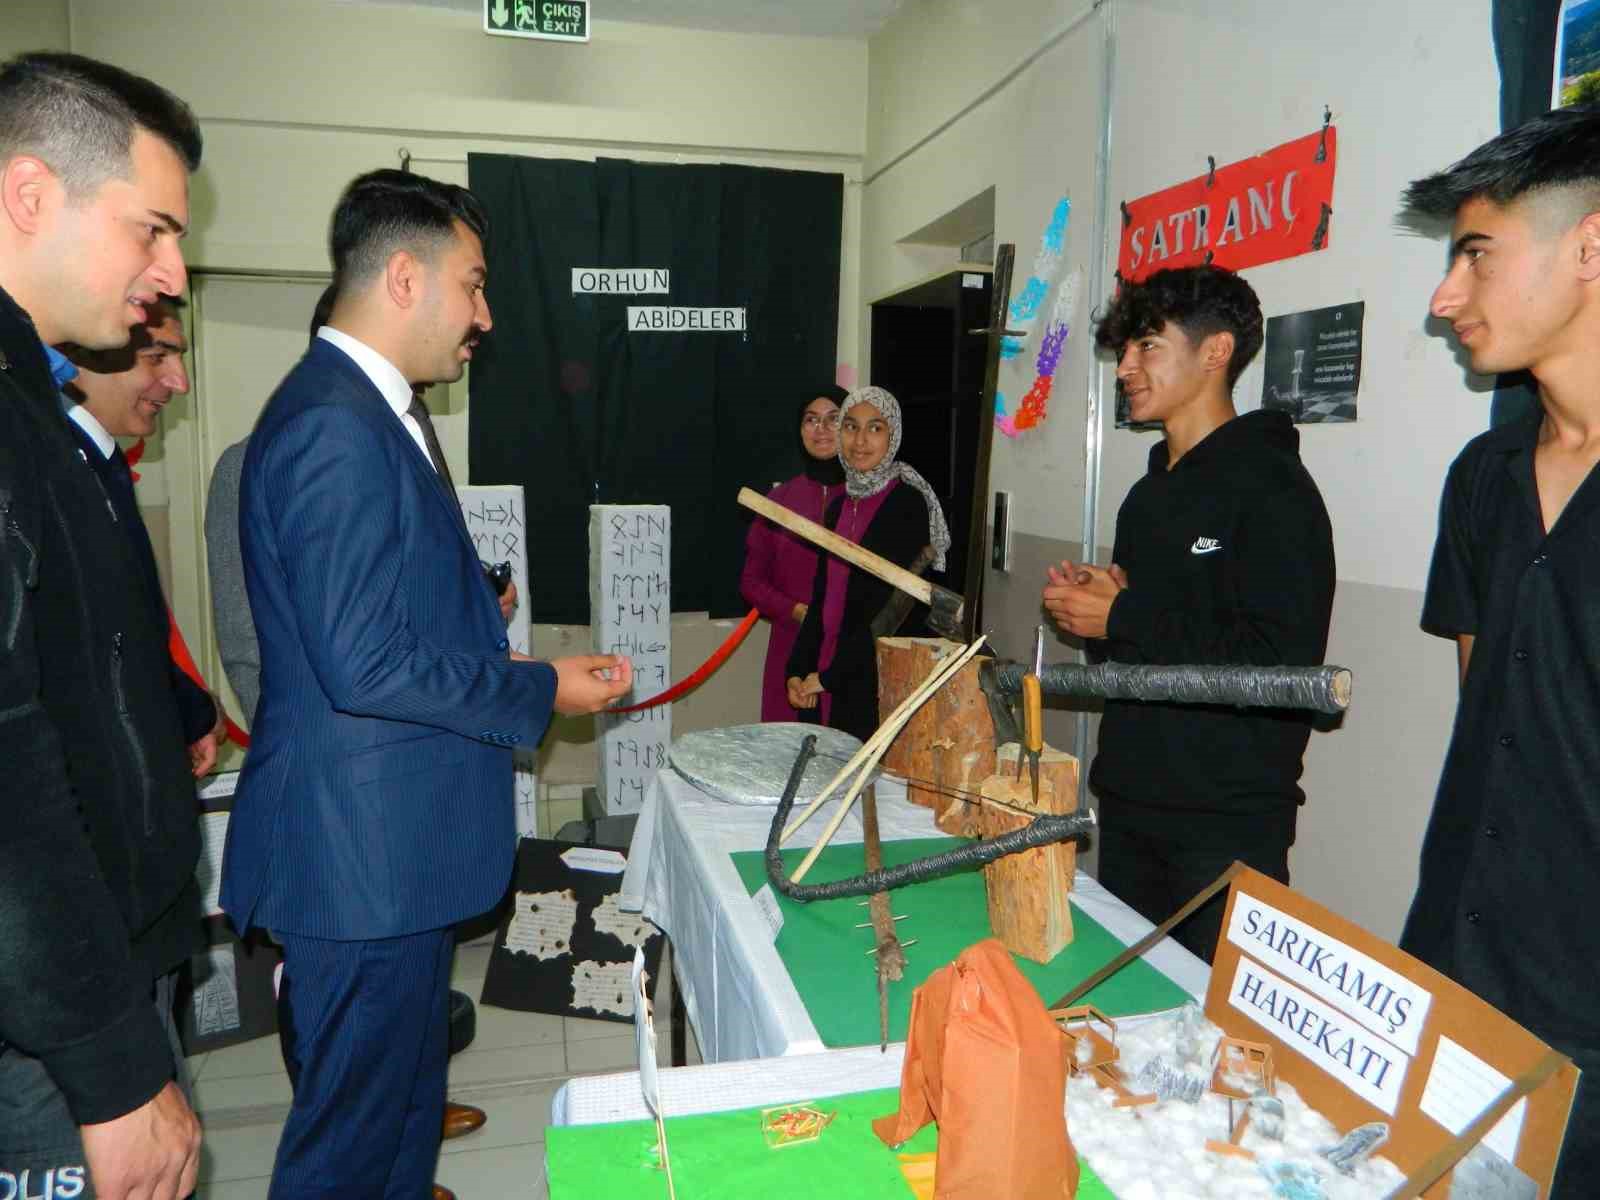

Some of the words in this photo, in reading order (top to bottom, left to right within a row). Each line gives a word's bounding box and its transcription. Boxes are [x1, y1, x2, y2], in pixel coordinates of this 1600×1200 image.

[542, 3, 581, 23] ÇIKIŞ
[543, 20, 581, 33] EXIT
[1130, 171, 1300, 269] SATRANÇ
[579, 269, 668, 292] ORHUN
[1196, 536, 1219, 549] NIKE
[1242, 908, 1413, 1035] SARIKAMIŞ
[1238, 972, 1393, 1091] HAREKATI
